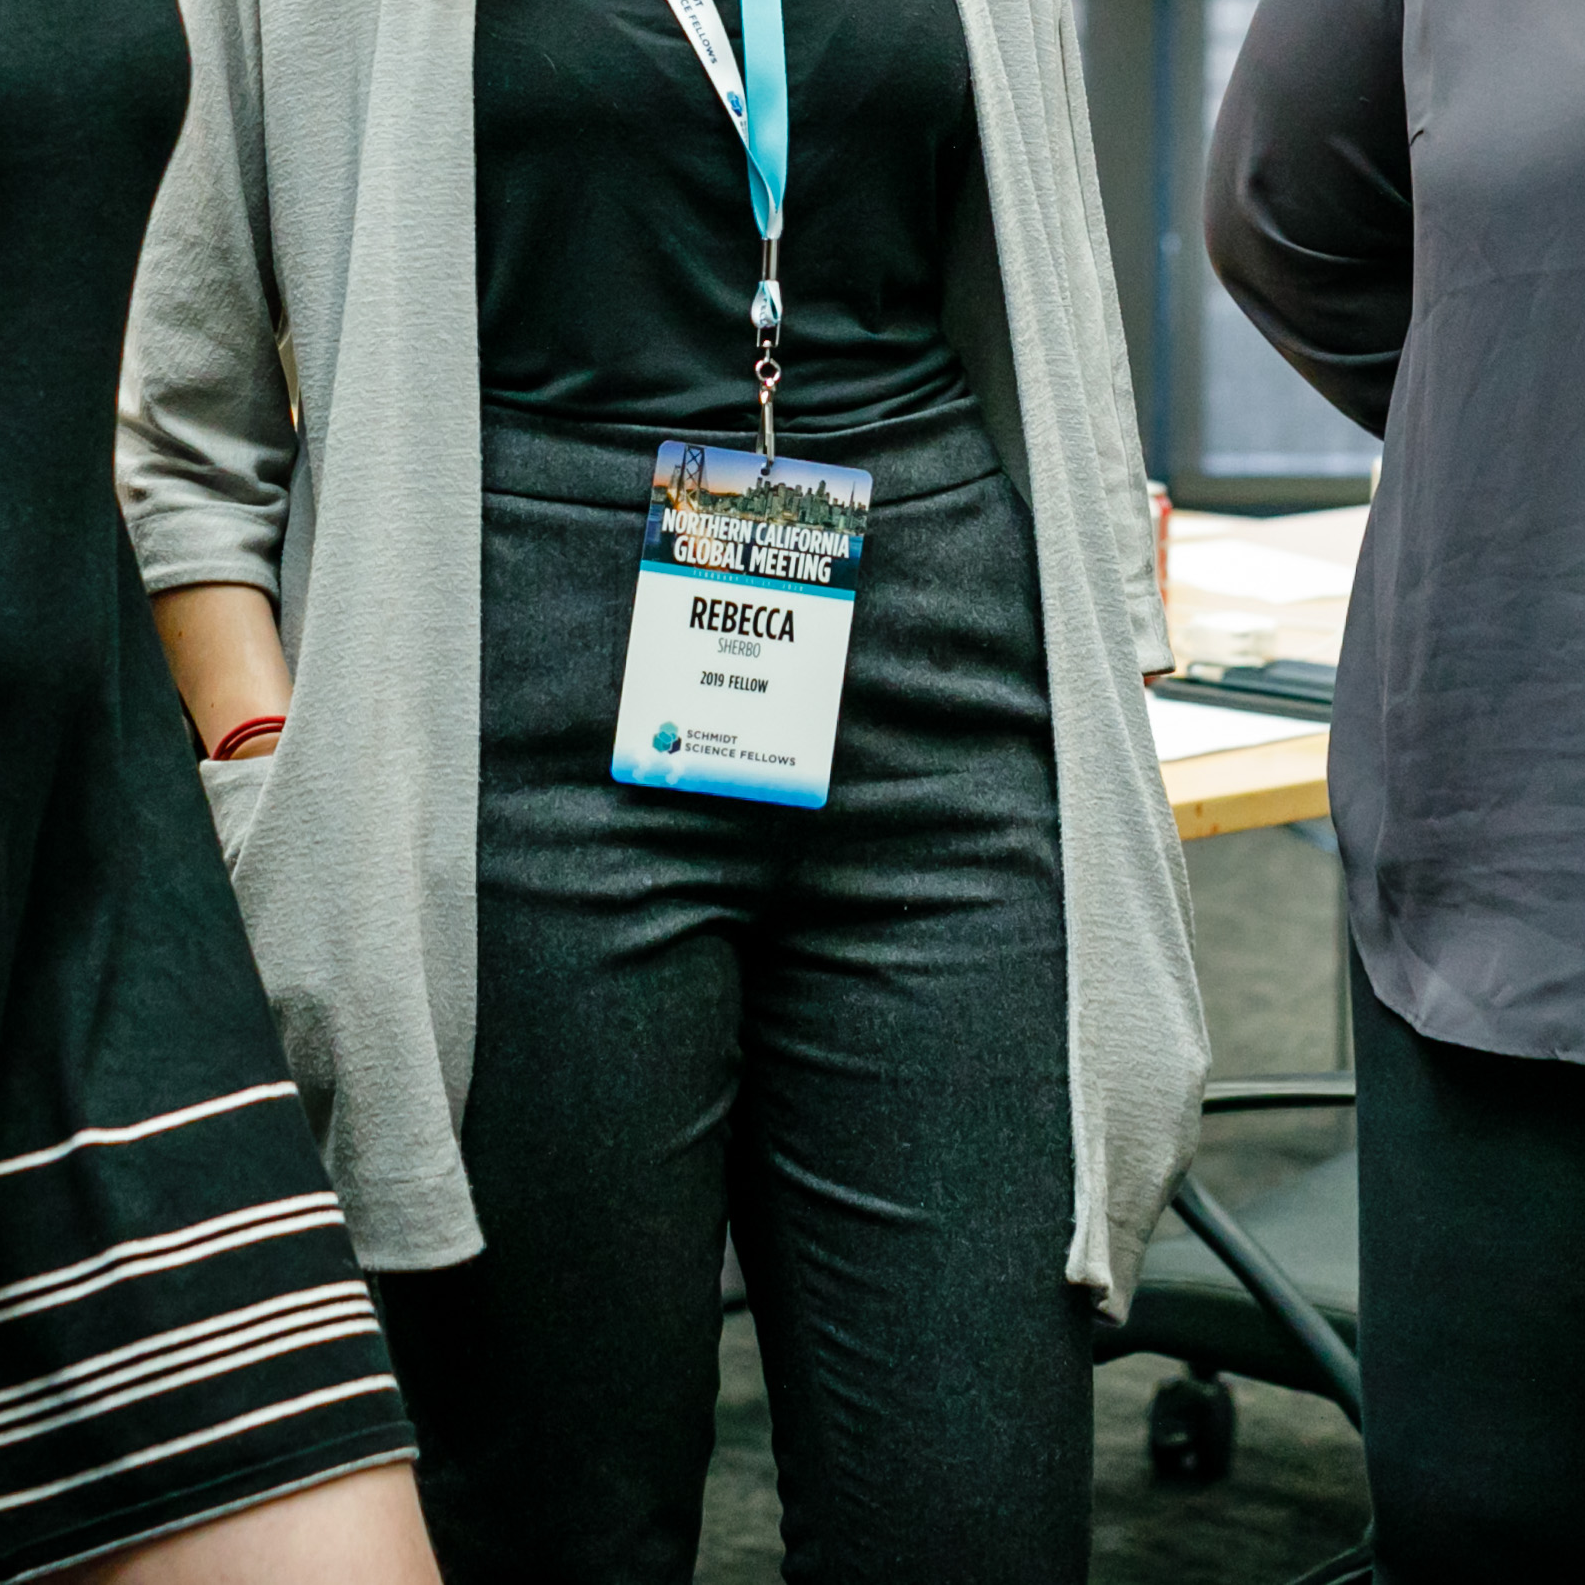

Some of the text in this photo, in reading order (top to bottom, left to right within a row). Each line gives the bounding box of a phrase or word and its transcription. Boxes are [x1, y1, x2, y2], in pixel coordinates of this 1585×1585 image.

[688, 14, 718, 65] FELLOWS
[662, 508, 850, 559] NORTHERN CALIFORNIA
[673, 535, 832, 583] GLOBAL MEETING
[690, 596, 794, 642] REBECCA
[717, 637, 761, 658] SHERBO
[700, 671, 769, 693] 2019 FELLOW
[685, 742, 796, 766] SCIENCE FELLOWS
[686, 729, 738, 744] SCHMIDT
